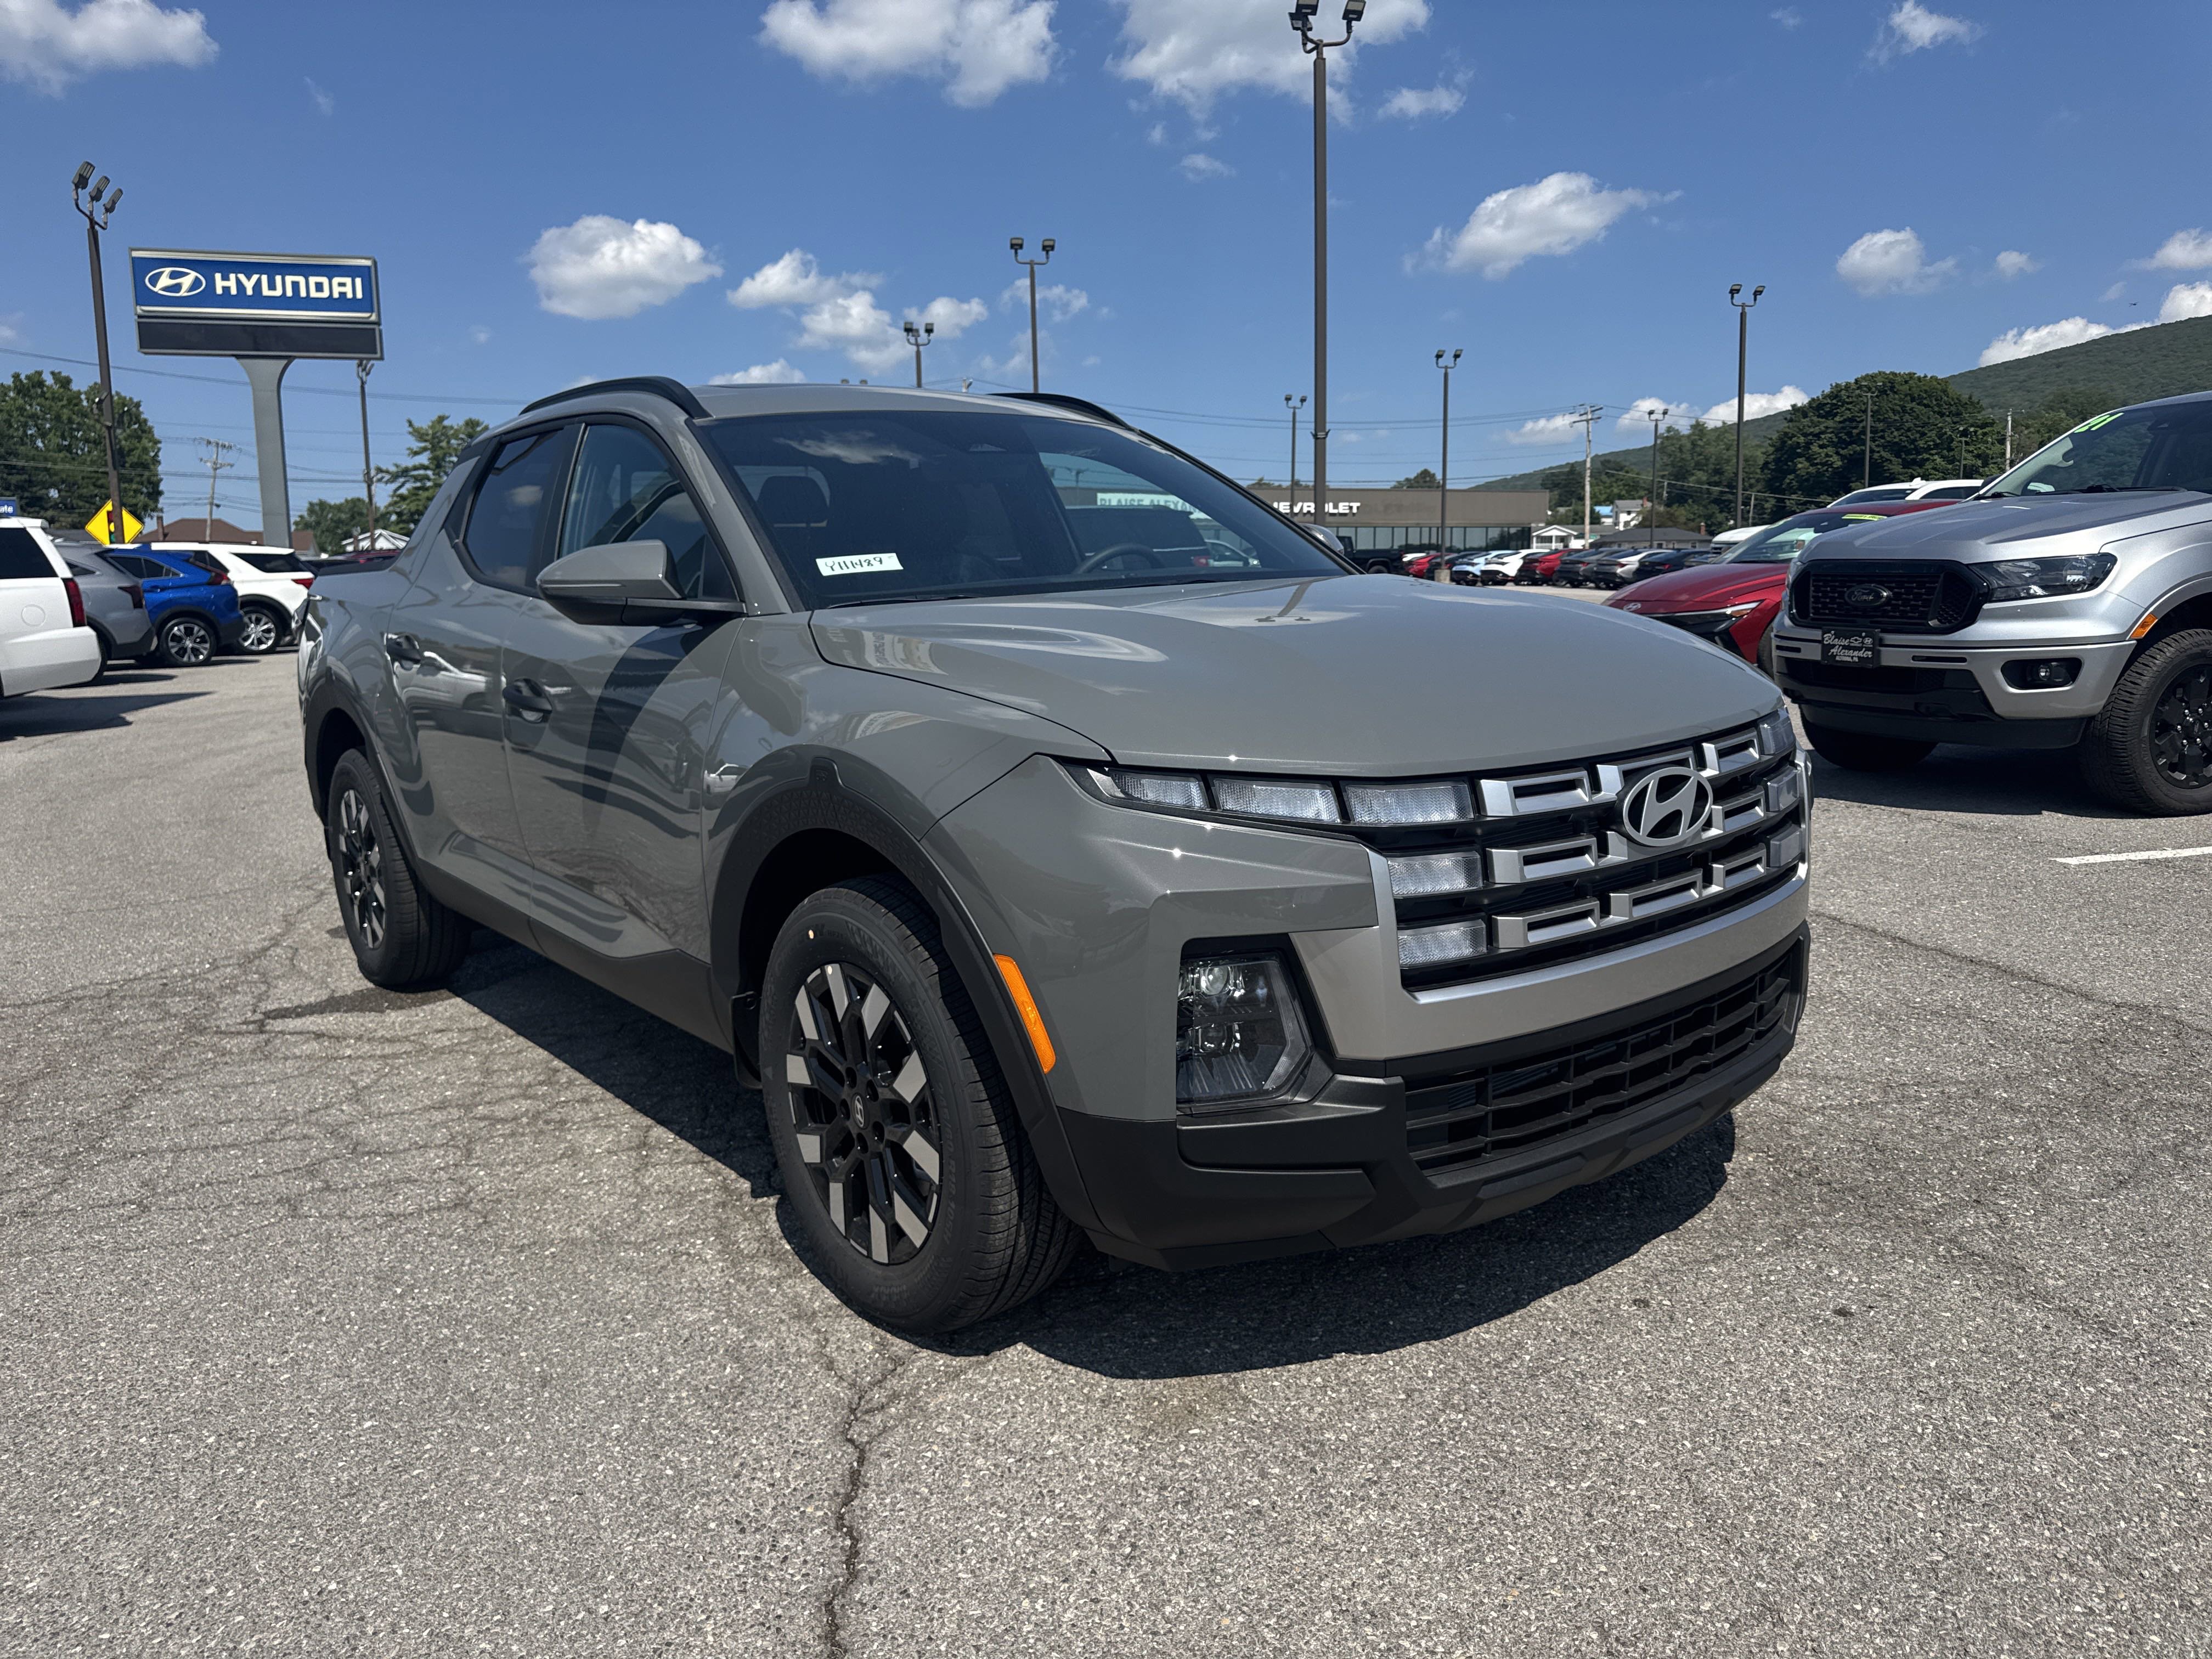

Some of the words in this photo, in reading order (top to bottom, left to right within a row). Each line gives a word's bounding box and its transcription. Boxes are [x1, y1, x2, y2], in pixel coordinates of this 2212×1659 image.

[215, 273, 363, 299] HYUNDAI
[1099, 498, 1144, 506] BLAISE
[1149, 498, 1200, 514] ALEXAN
[1823, 633, 1849, 646] Blaise
[1828, 645, 1872, 658] Alexander
